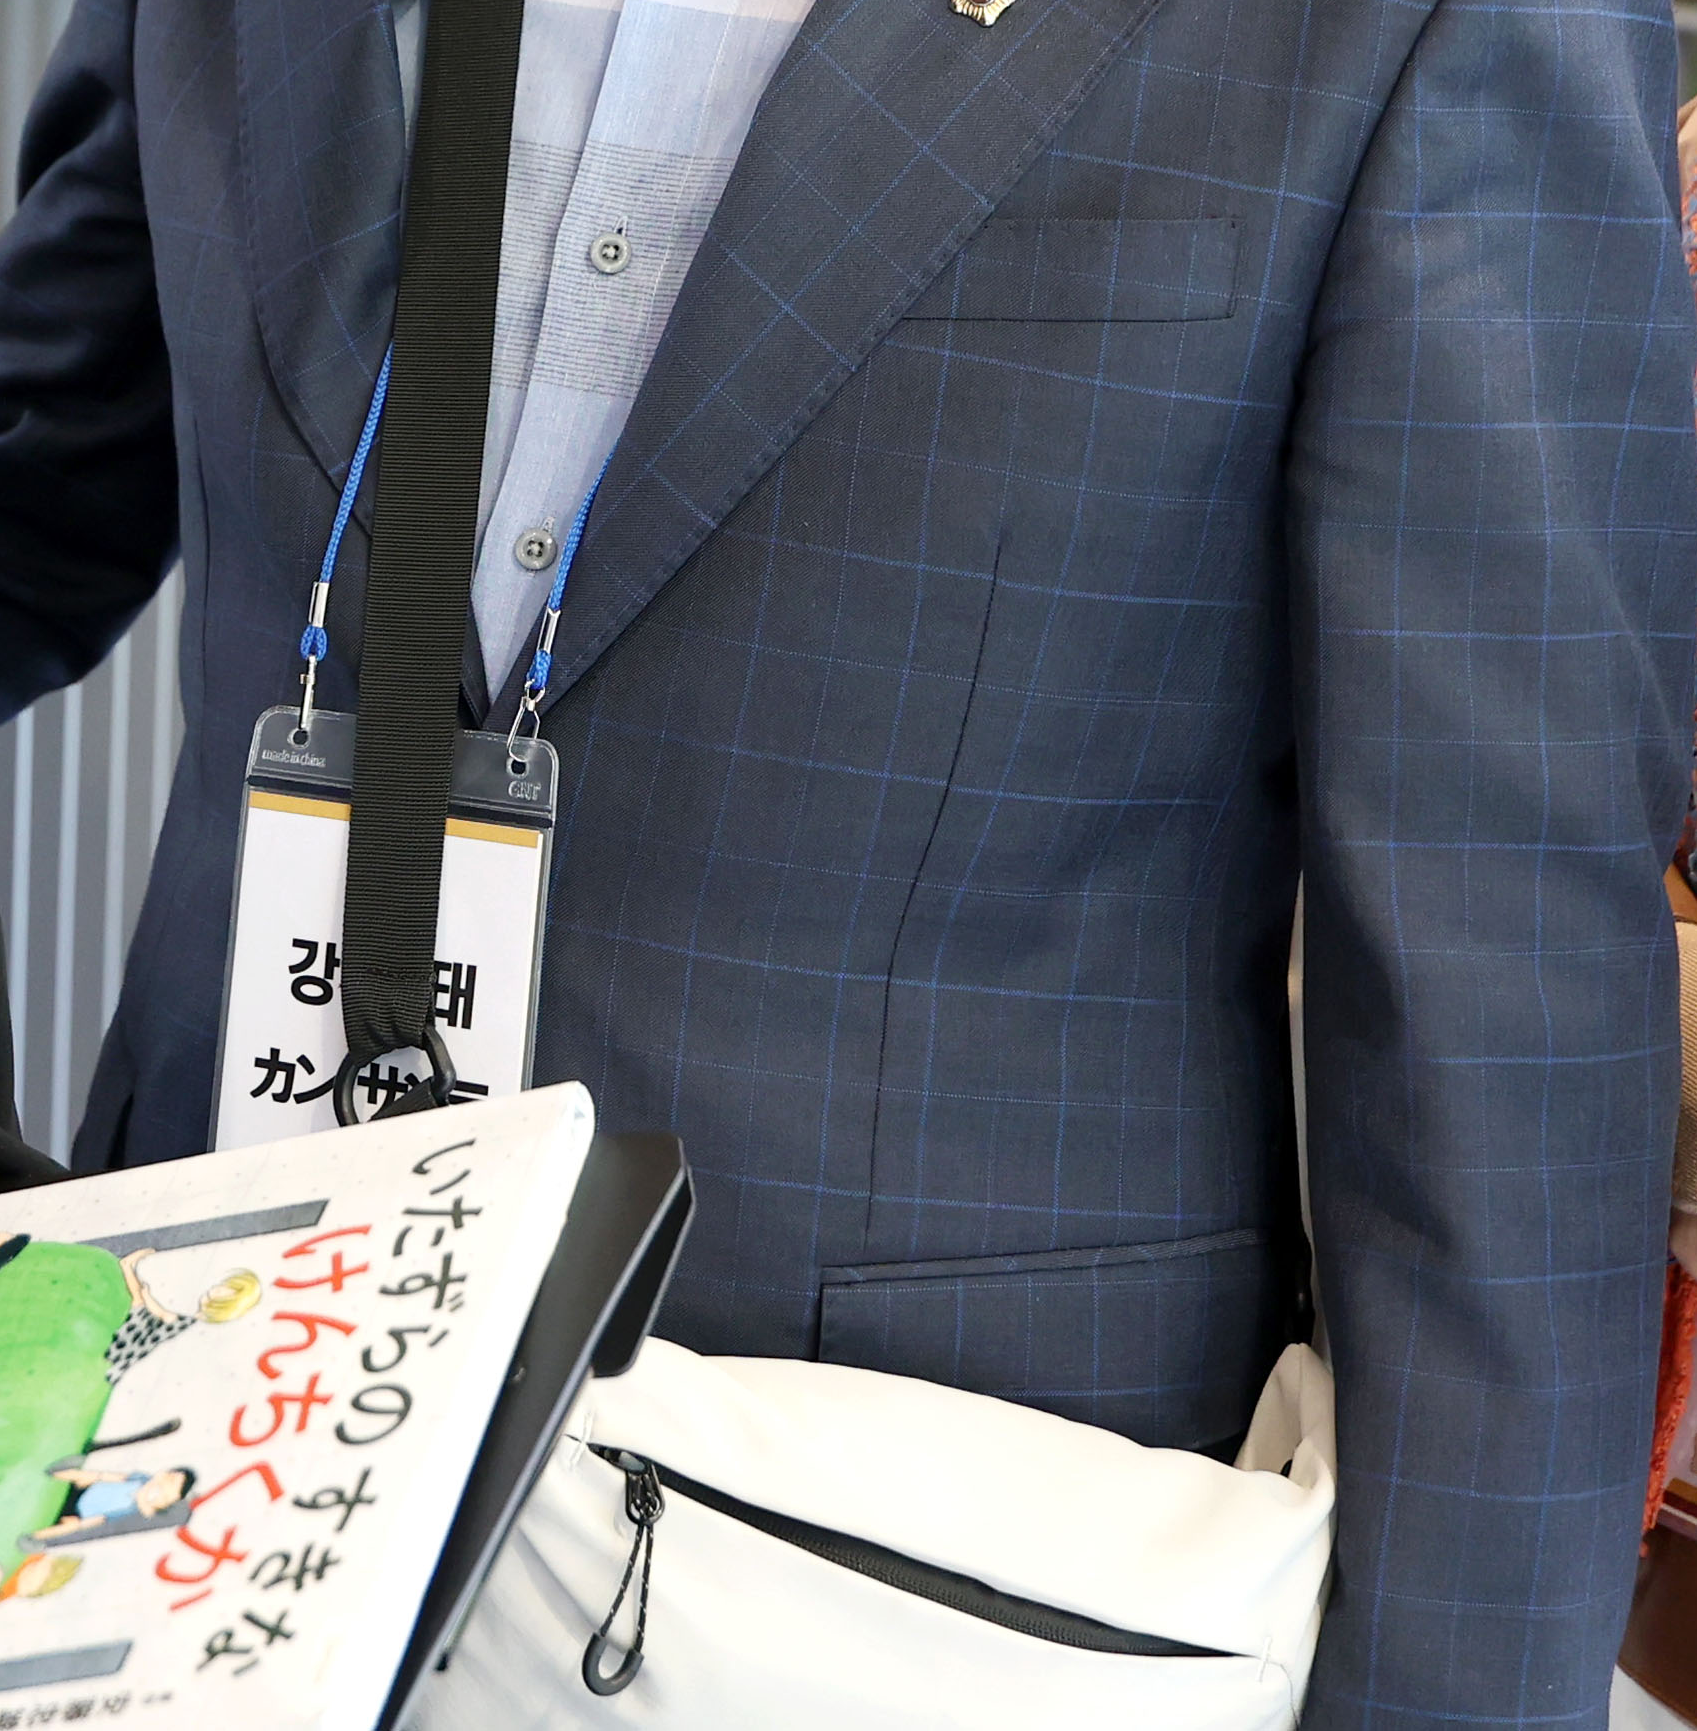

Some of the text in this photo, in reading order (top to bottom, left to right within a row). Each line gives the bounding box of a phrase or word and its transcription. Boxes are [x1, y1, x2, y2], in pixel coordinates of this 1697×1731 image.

[288, 937, 477, 1030] 강태
[155, 1225, 372, 1612] けんちくか
